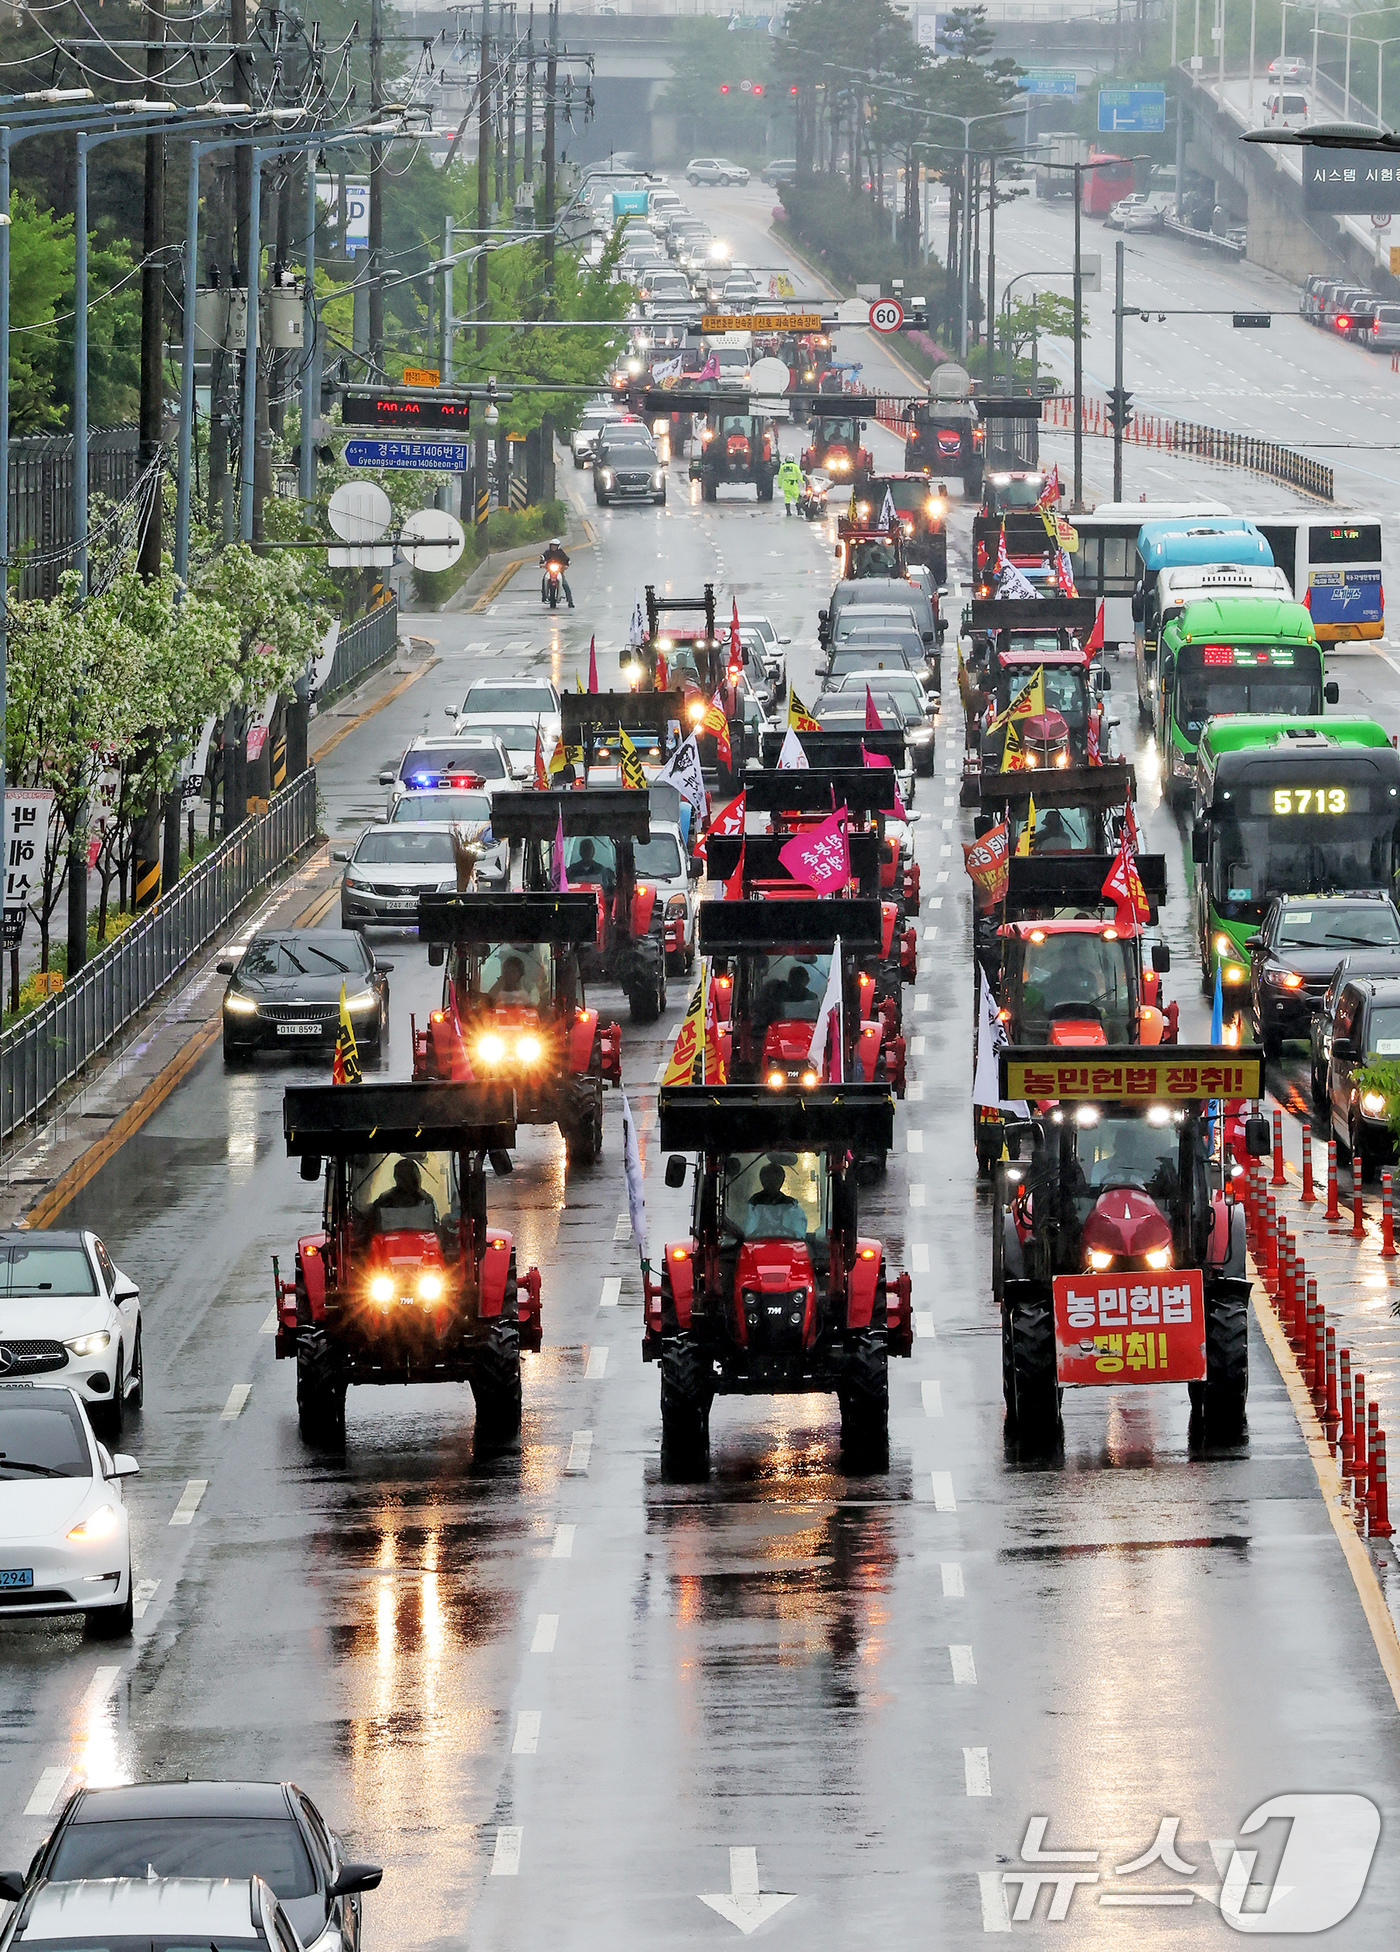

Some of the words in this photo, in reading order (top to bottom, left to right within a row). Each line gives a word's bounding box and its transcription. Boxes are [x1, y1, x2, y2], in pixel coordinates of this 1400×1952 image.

[1313, 168, 1356, 182] 시스템
[704, 318, 734, 329] 후면번호판
[758, 317, 773, 328] 신호
[775, 317, 819, 328] 과속단속장비
[876, 309, 896, 324] 60
[235, 329, 246, 338] 50
[378, 444, 465, 460] 경수대로1406번길
[358, 457, 417, 468] Gyeongsu-daero
[418, 458, 464, 470] 1406beon-gil
[1274, 789, 1346, 815] 5713
[1024, 1067, 1157, 1095] 농민헌법
[1165, 1067, 1243, 1094] 쟁취!
[1066, 1284, 1192, 1328] 농민헌법
[1093, 1331, 1168, 1373] 쟁취!
[0, 1571, 26, 1584] 294
